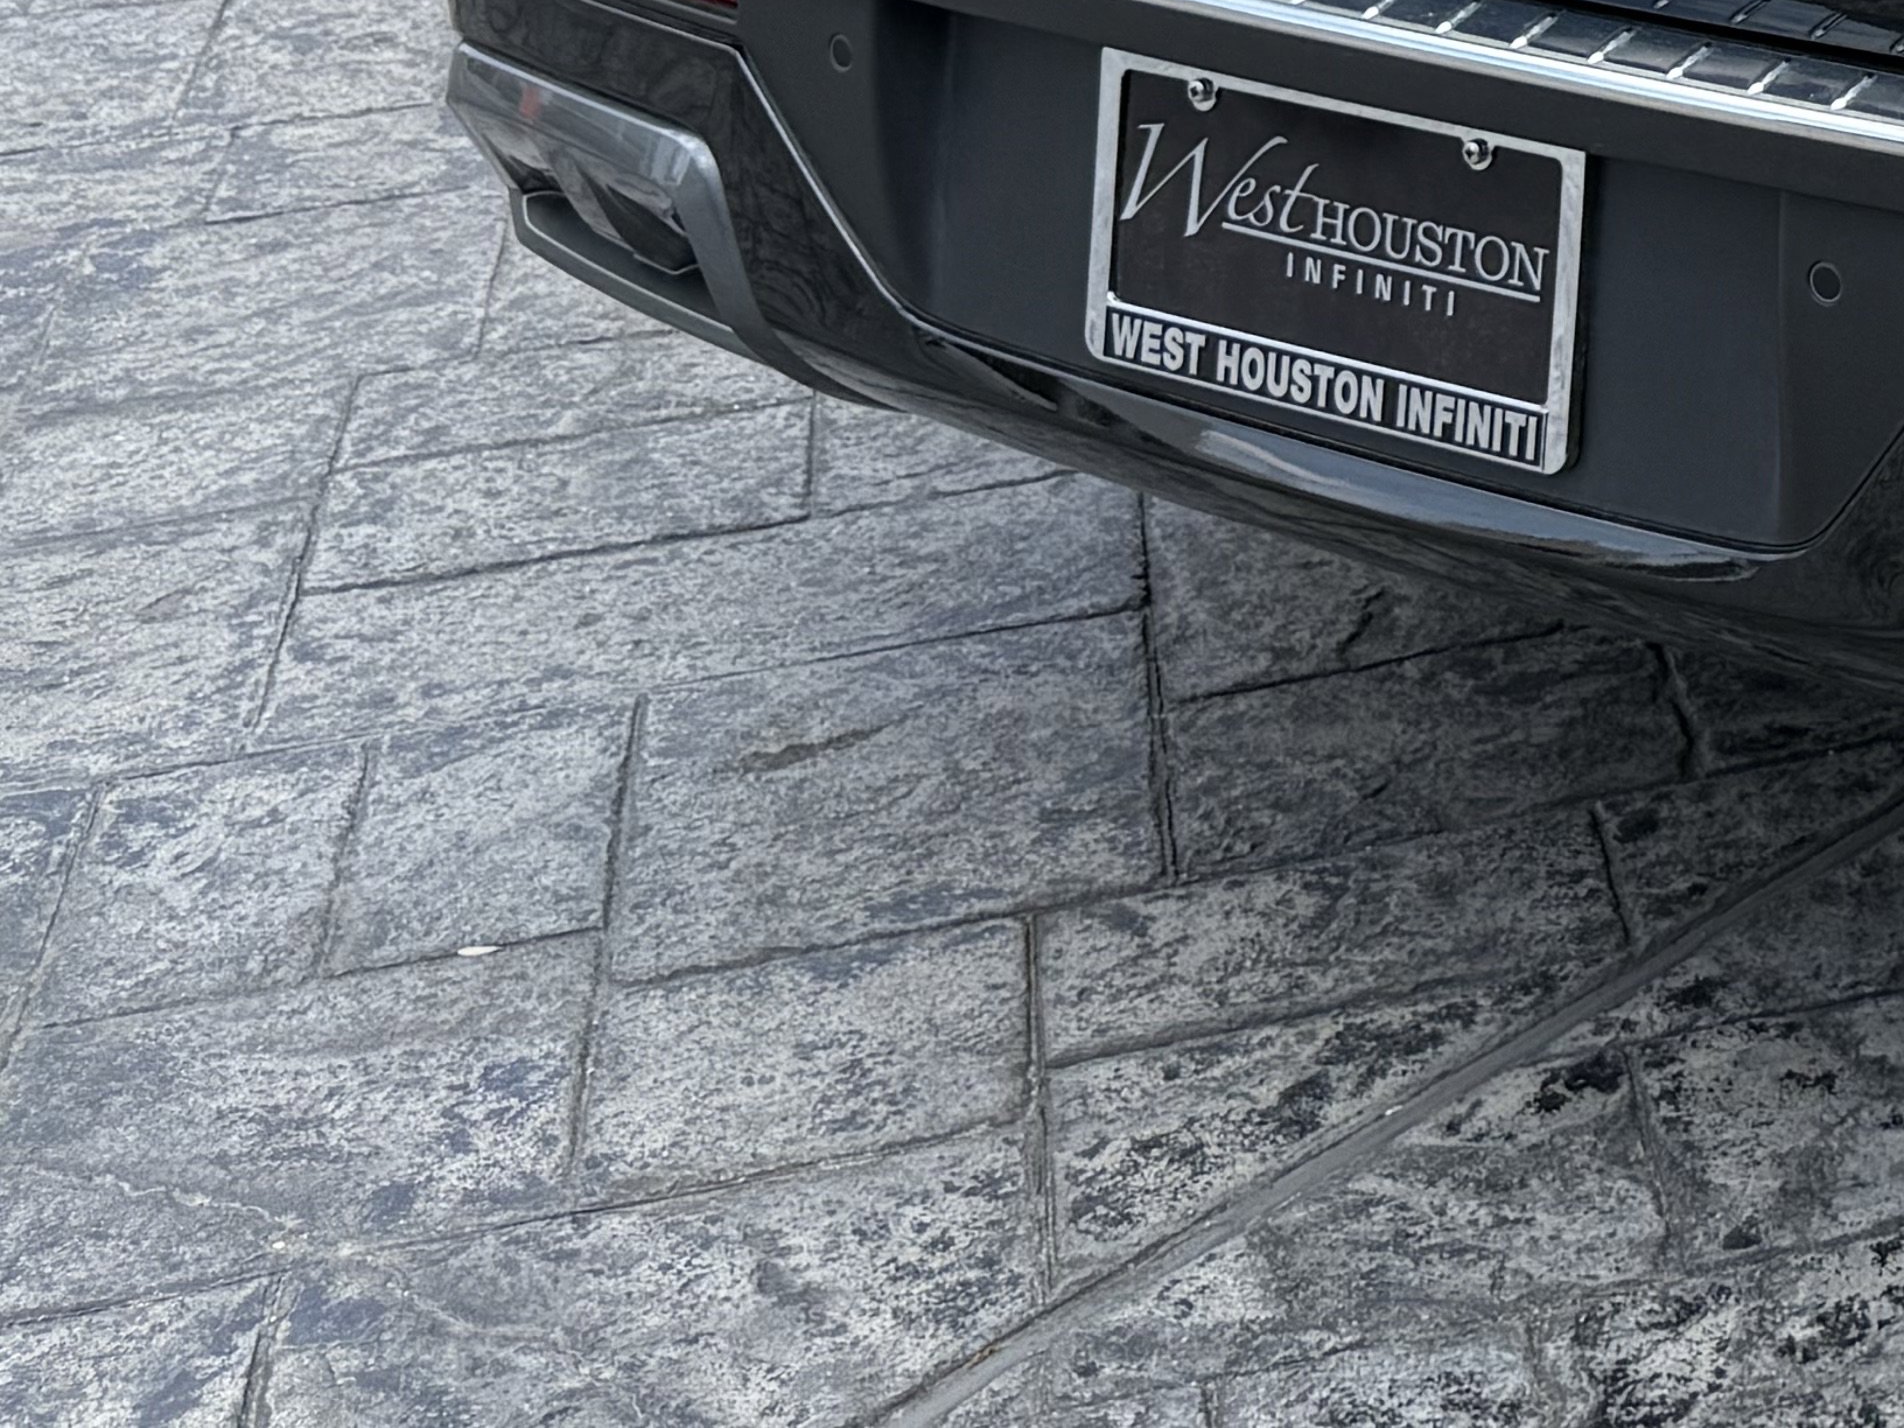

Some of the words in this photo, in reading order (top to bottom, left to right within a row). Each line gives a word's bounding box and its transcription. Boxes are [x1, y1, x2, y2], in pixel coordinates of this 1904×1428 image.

[1285, 252, 1456, 316] INFINITI
[1111, 312, 1205, 373] WEST
[1216, 340, 1385, 422] HOUSTON
[1395, 384, 1539, 461] INFINITI
